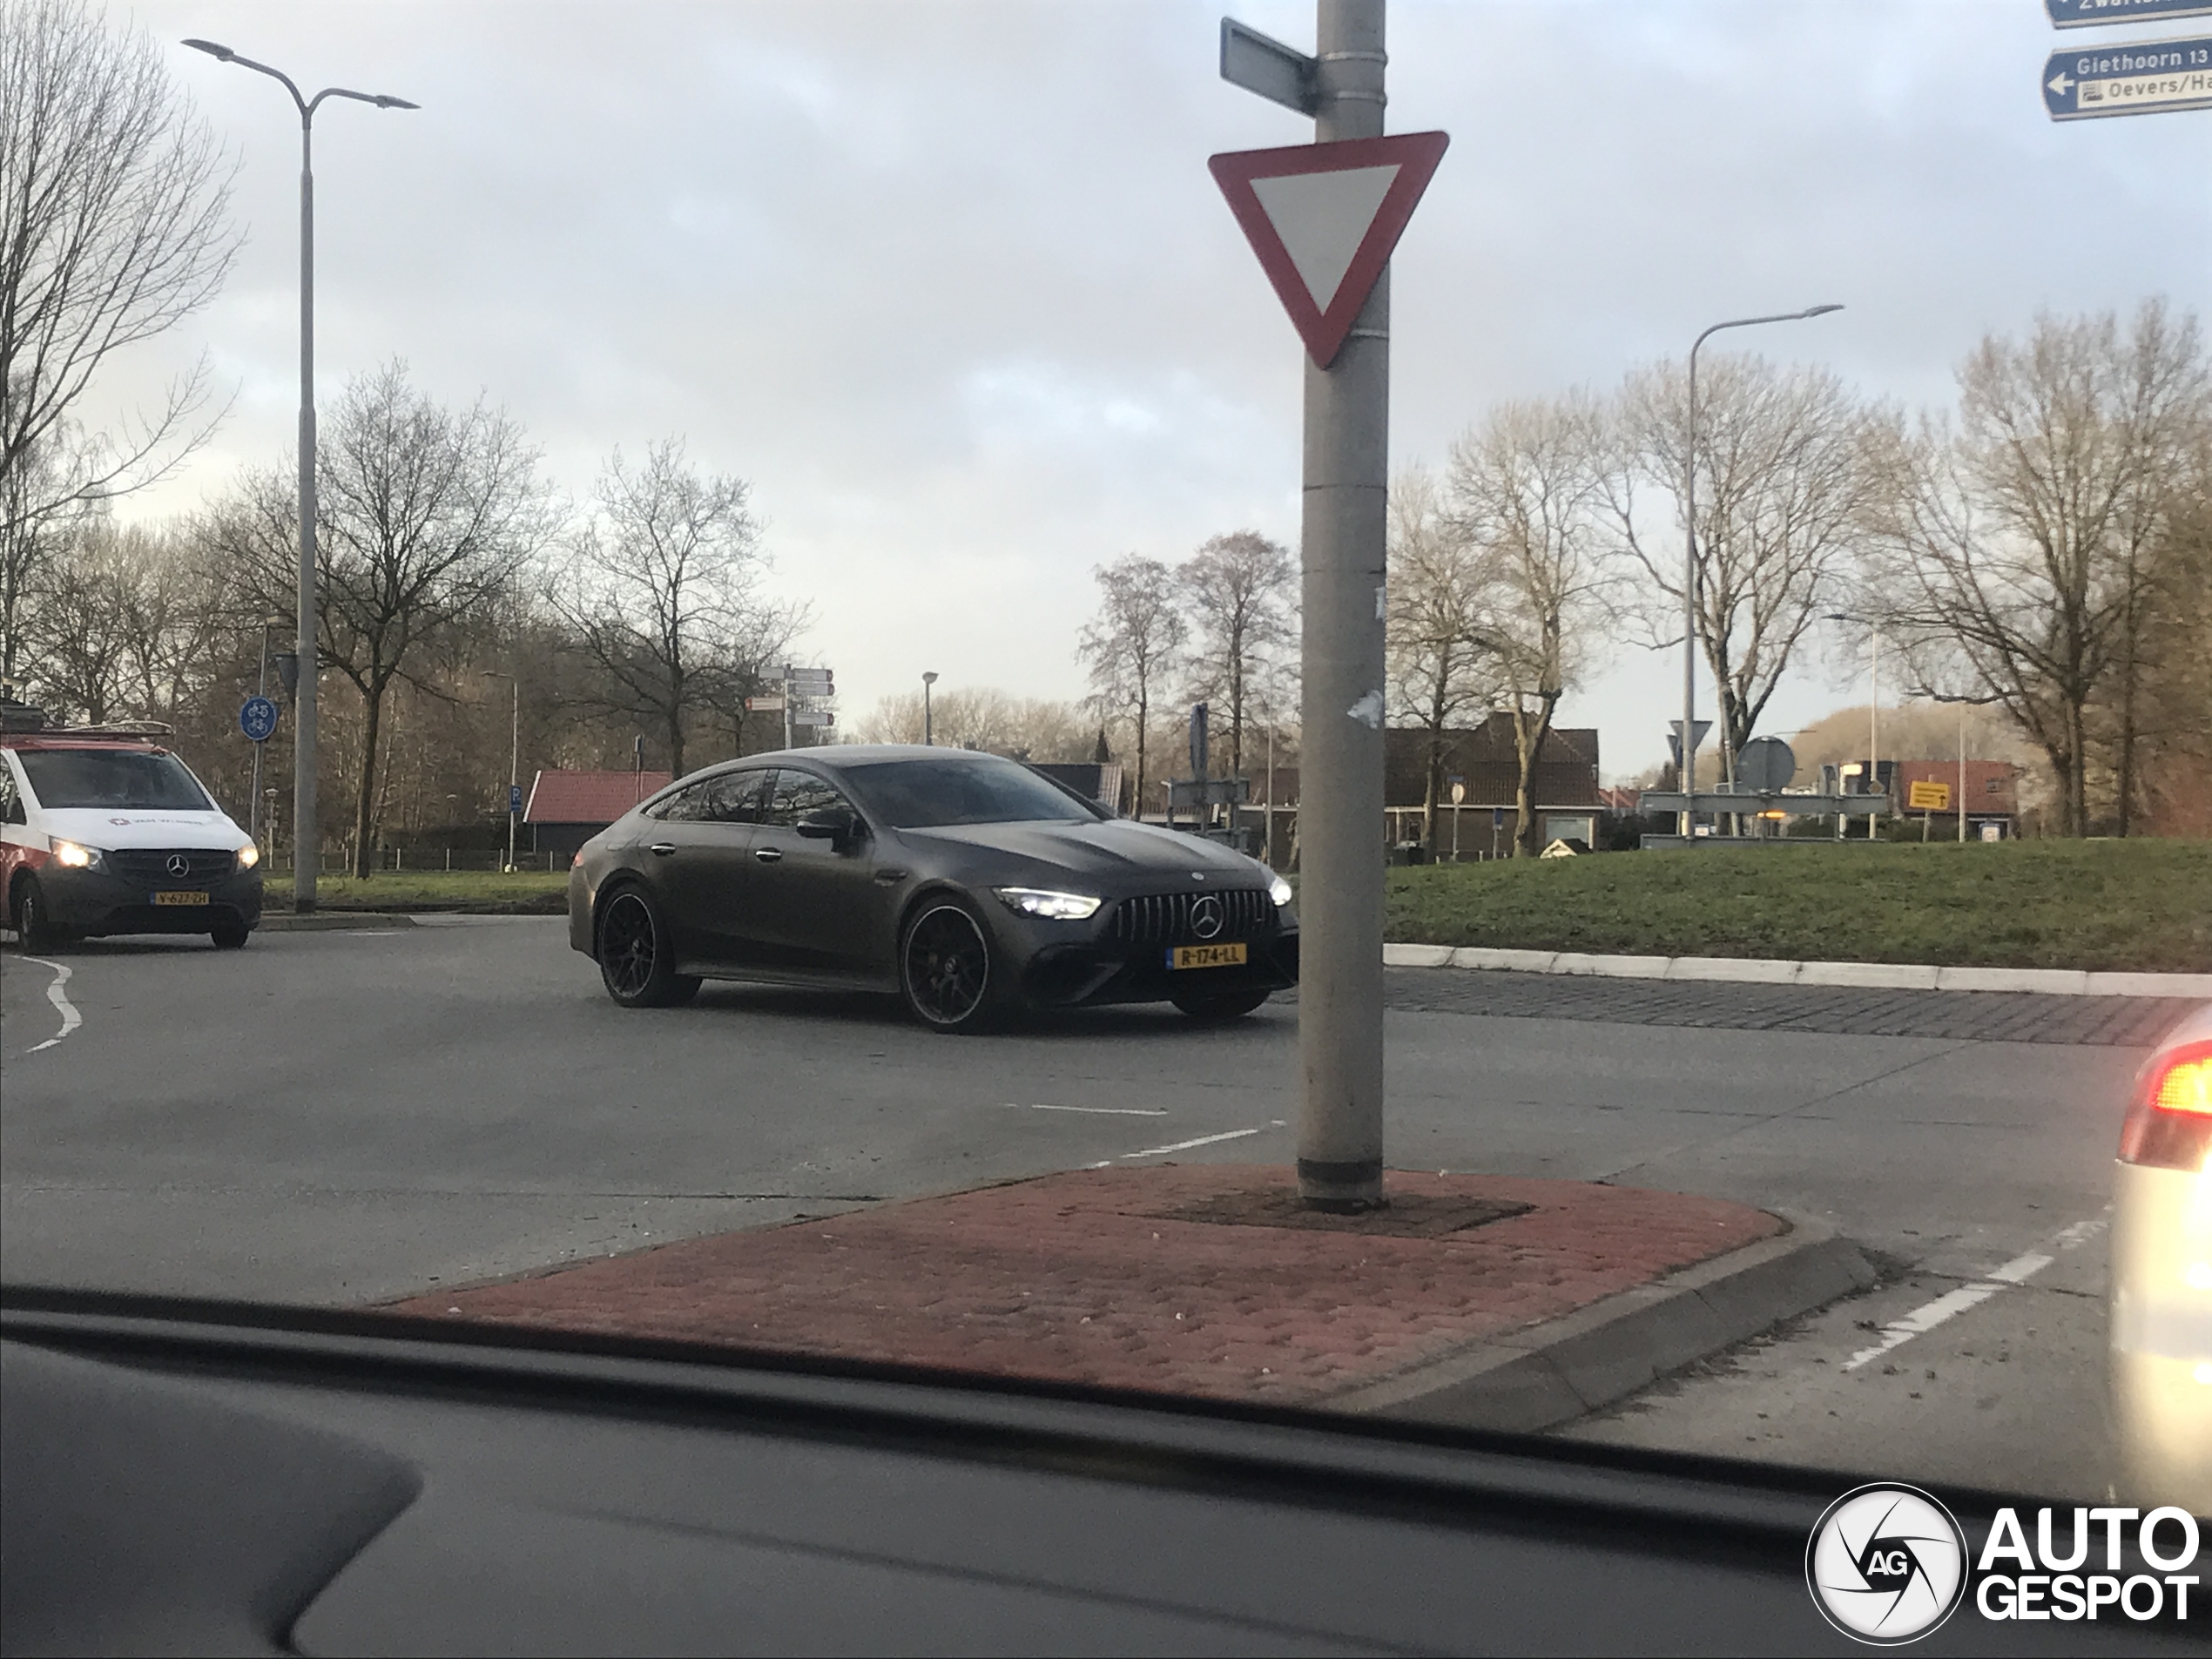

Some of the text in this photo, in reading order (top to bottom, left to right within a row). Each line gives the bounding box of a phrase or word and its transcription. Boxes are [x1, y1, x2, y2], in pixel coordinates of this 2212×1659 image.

[2077, 49, 2209, 75] Giethoorn 13
[1182, 946, 1240, 966] R-174-LL
